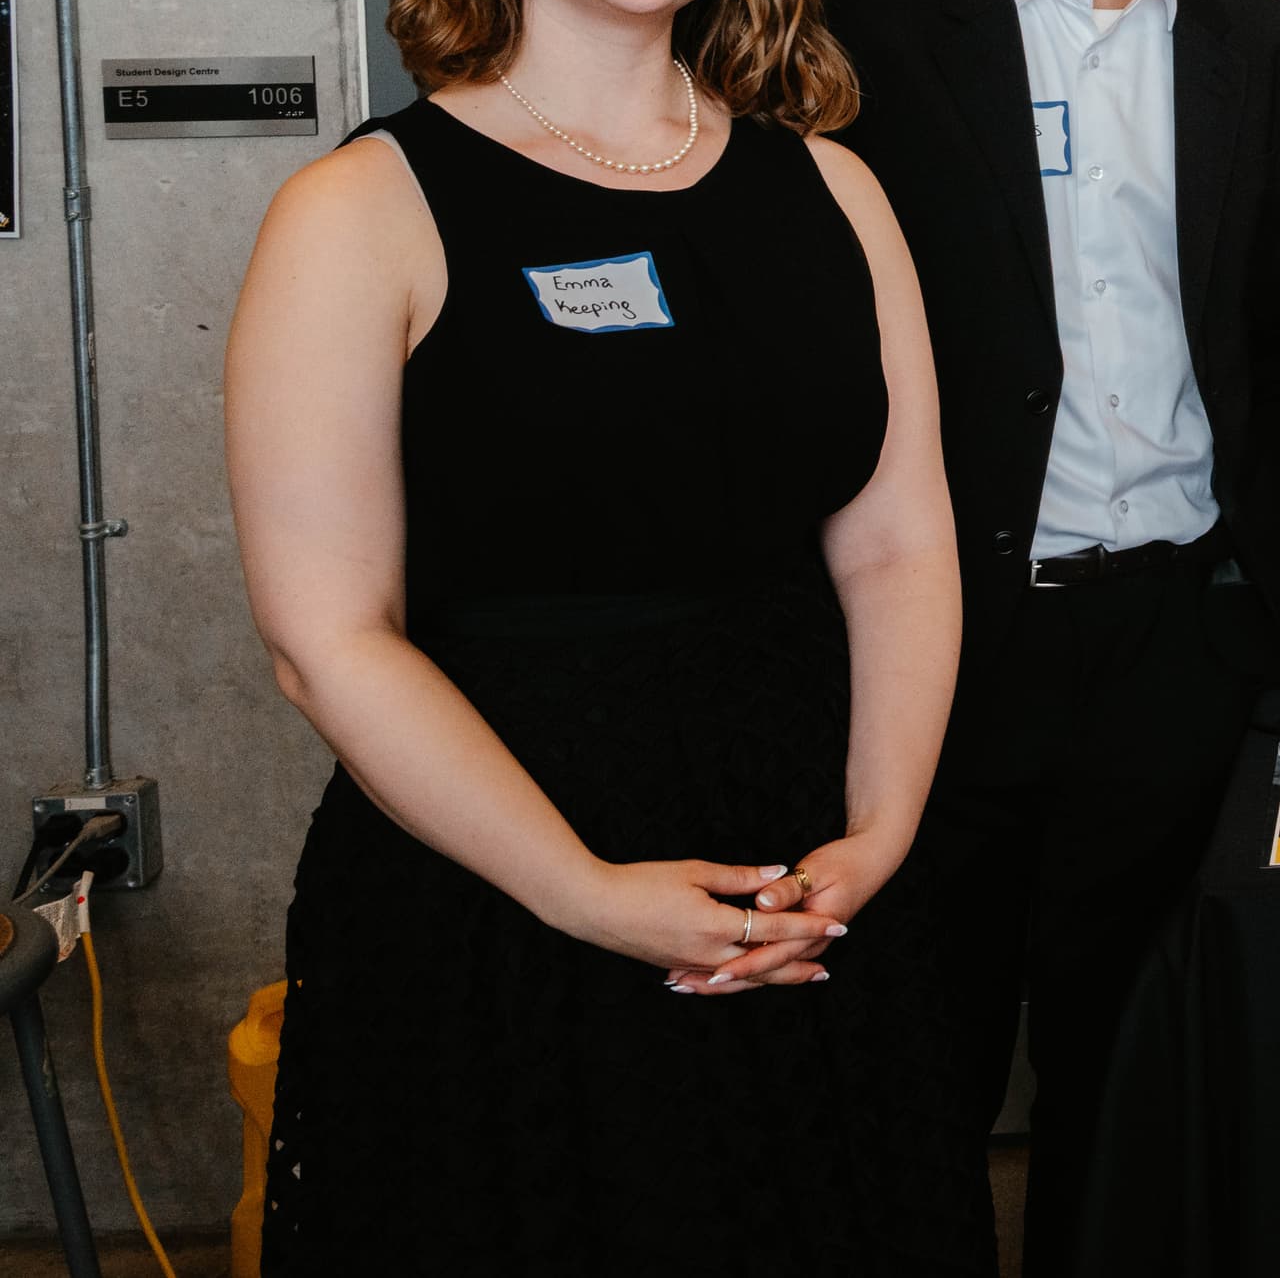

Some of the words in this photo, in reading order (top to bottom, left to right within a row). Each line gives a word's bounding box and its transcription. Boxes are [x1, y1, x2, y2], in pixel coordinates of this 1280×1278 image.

[115, 68, 153, 77] Student
[154, 67, 187, 78] Design
[189, 67, 220, 76] Centre
[117, 89, 150, 108] E5
[248, 86, 303, 106] 1006
[552, 275, 614, 291] Emma
[554, 298, 638, 320] Keeping
